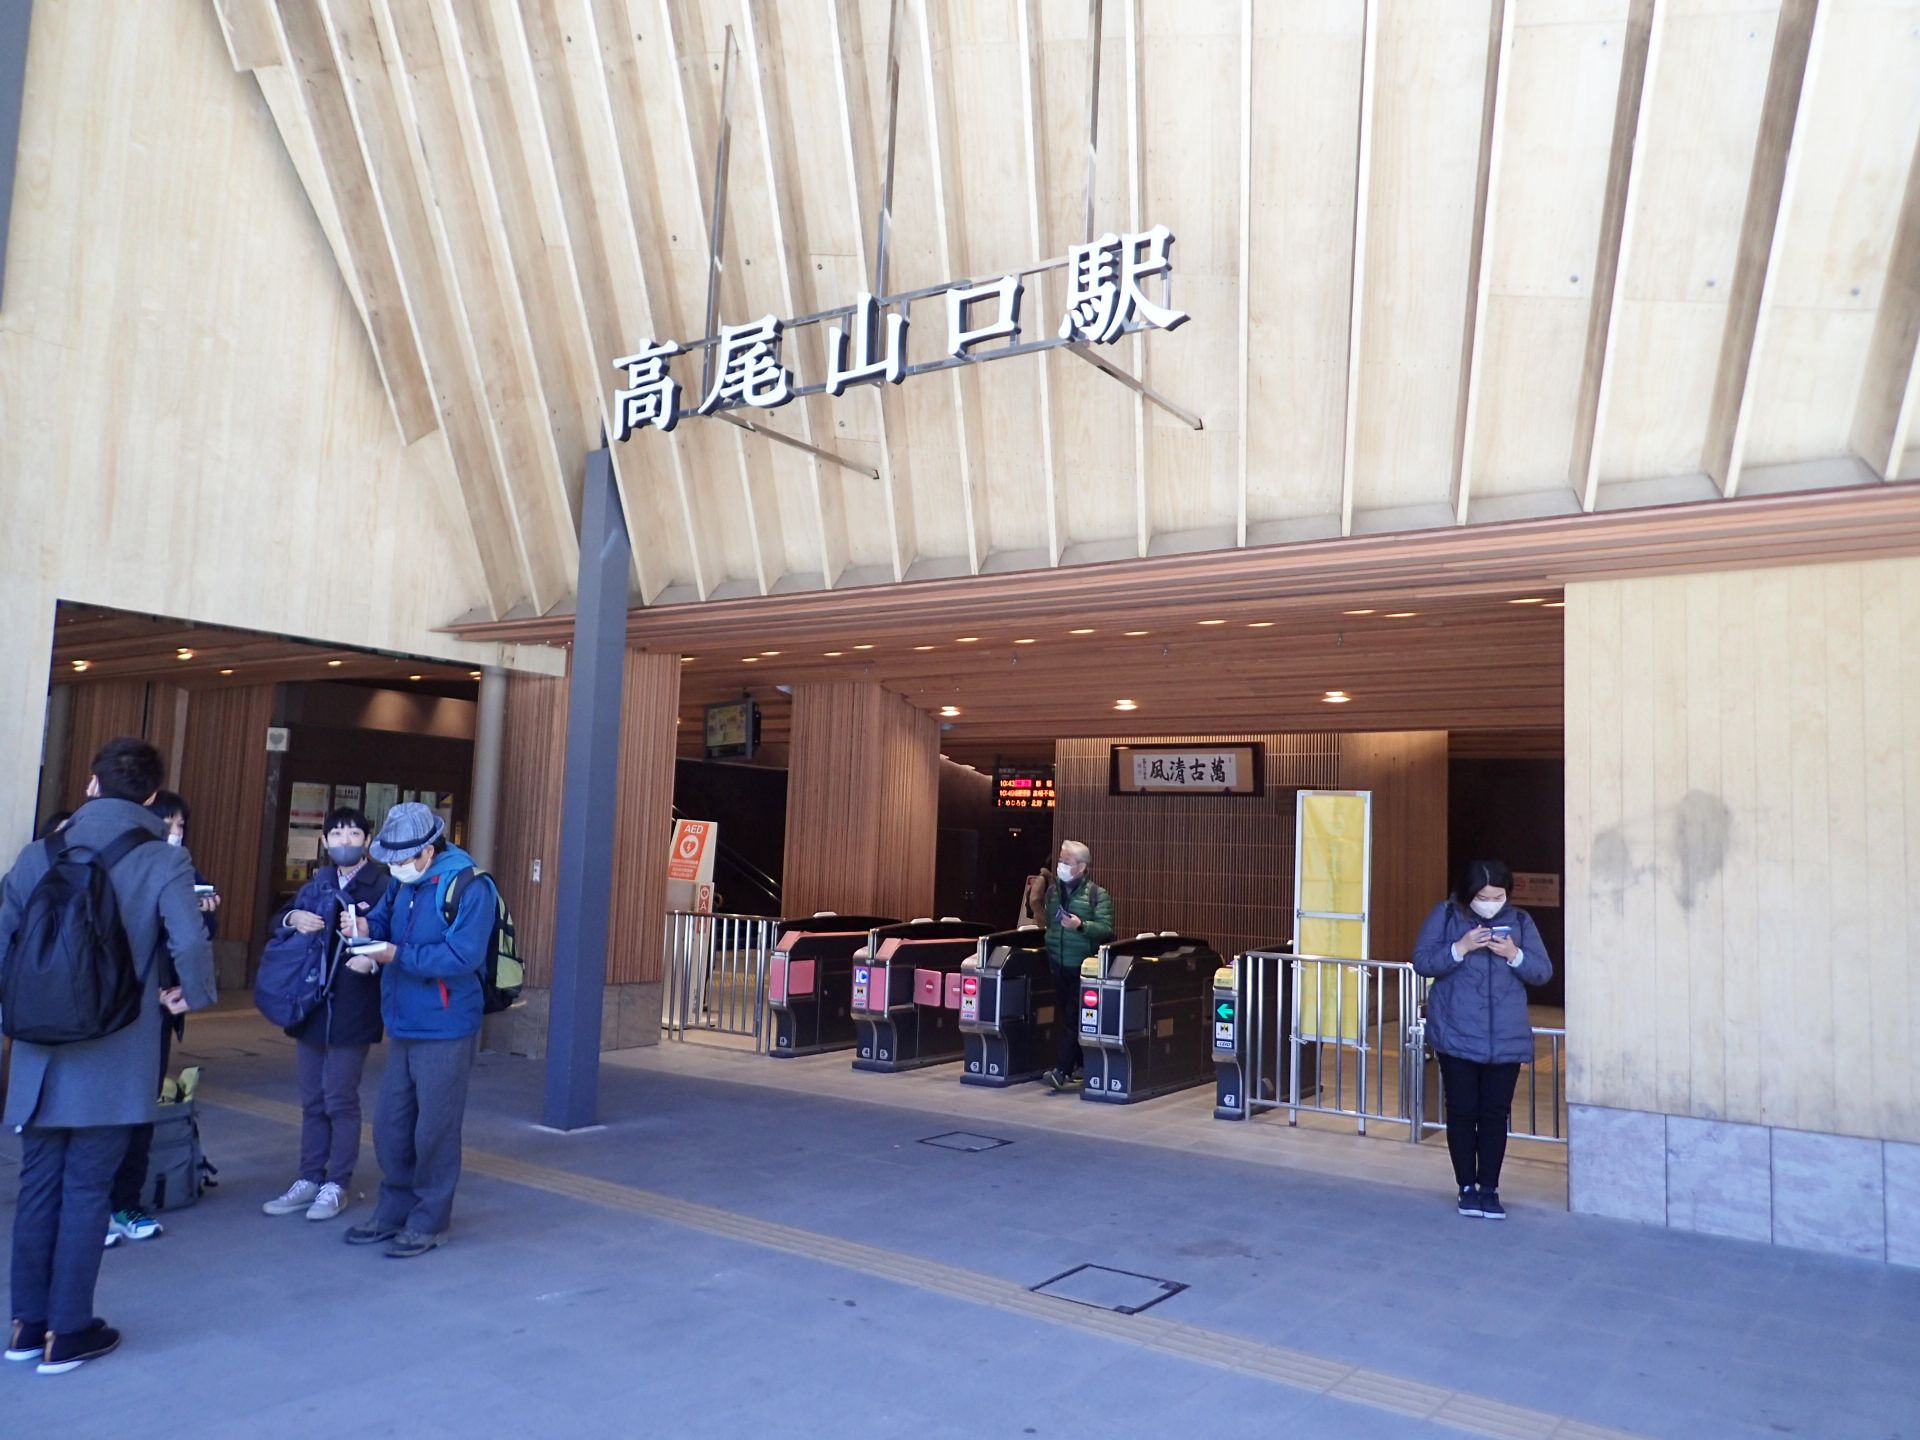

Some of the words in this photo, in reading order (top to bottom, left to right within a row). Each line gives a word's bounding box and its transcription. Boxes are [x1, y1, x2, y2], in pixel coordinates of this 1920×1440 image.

[612, 223, 1191, 441] 高尾山口駅
[684, 824, 704, 834] AED
[855, 969, 868, 984] IC
